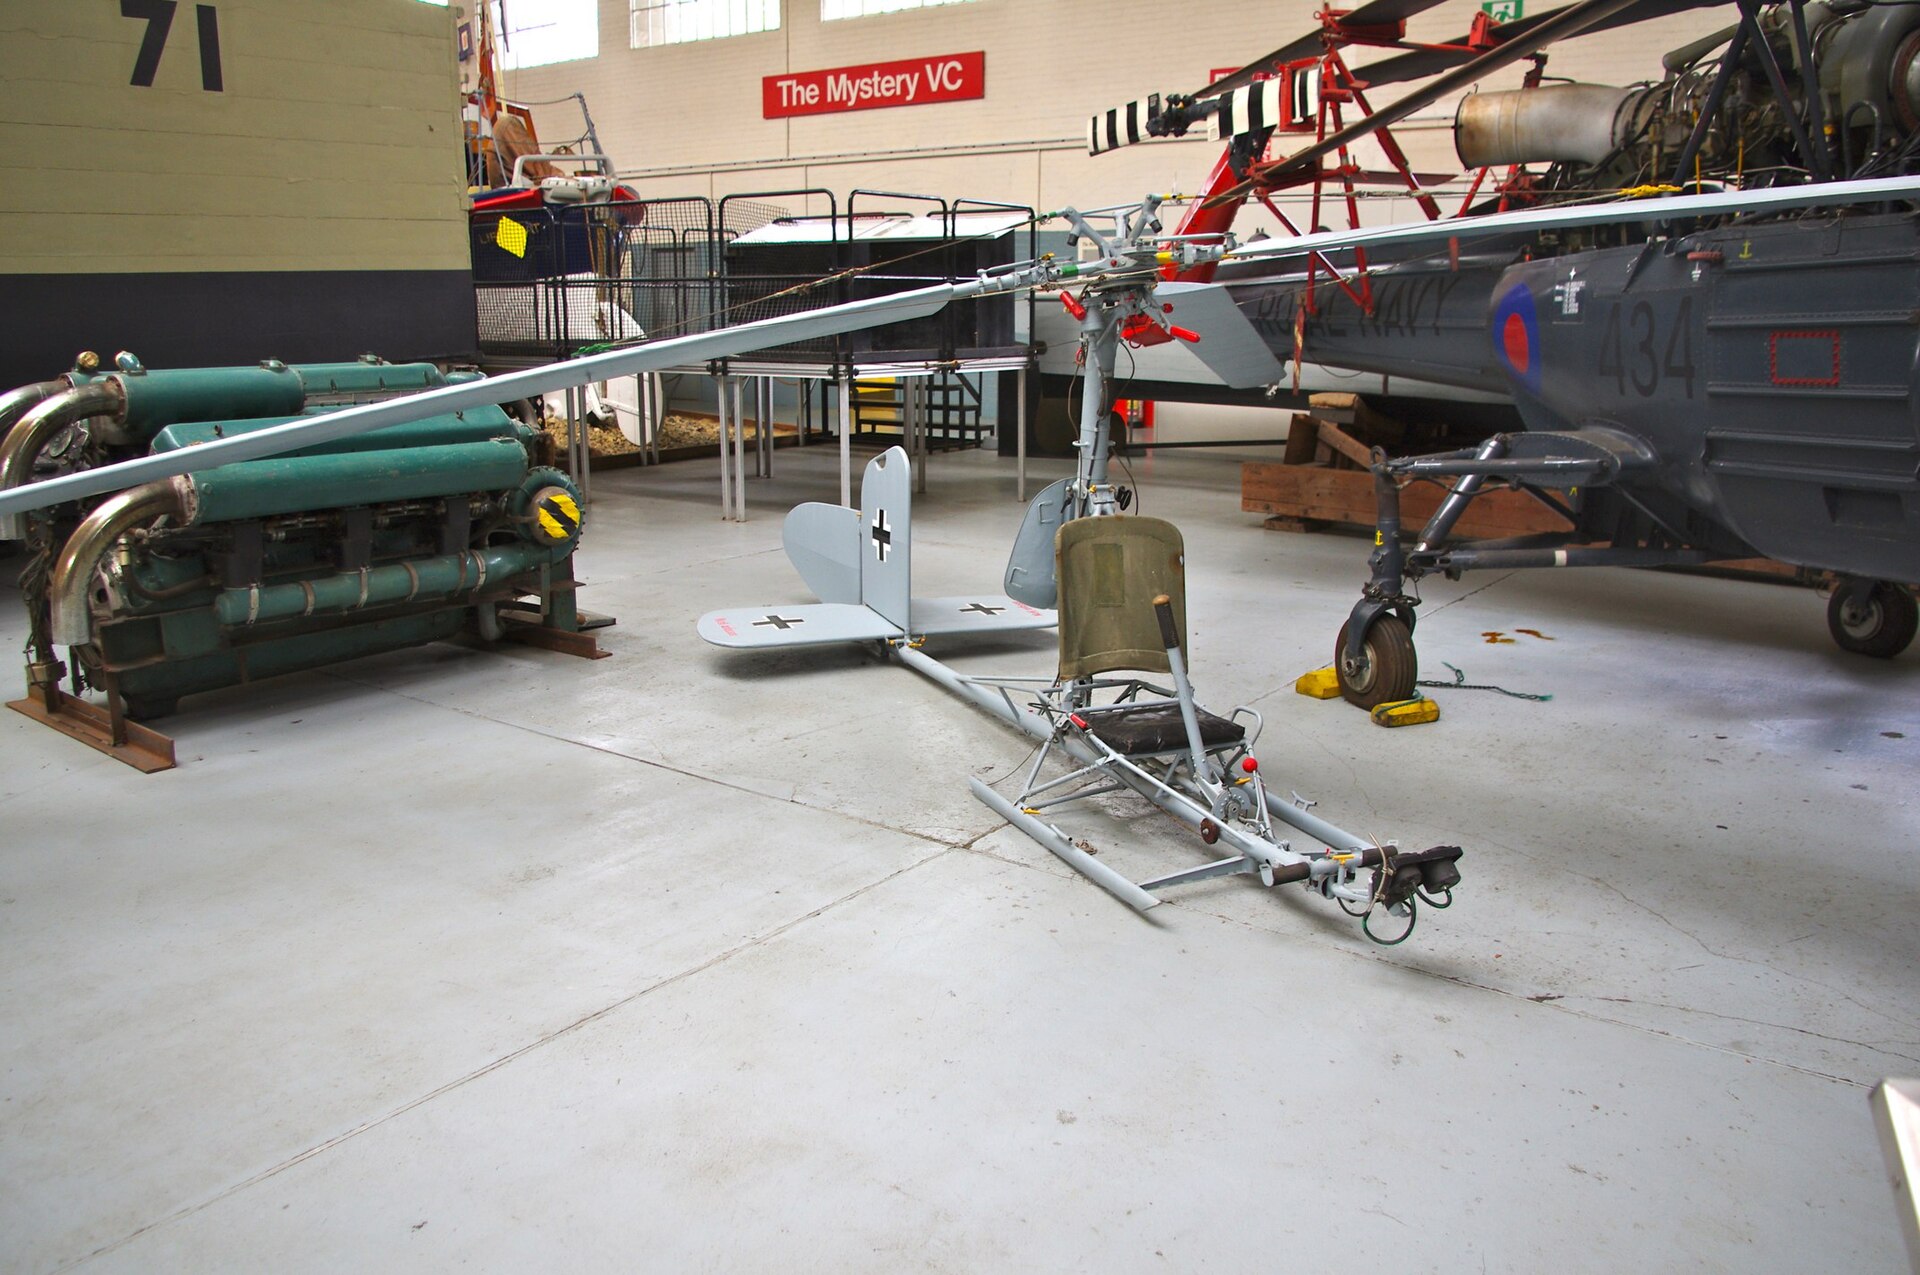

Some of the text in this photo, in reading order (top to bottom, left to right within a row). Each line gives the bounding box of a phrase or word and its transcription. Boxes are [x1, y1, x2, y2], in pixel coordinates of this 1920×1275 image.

[120, 0, 223, 92] 71
[776, 60, 964, 108] The Mystery VC
[479, 222, 541, 245] LIFAT
[1255, 275, 1463, 338] ROAL NAVY
[1599, 296, 1696, 400] 434
